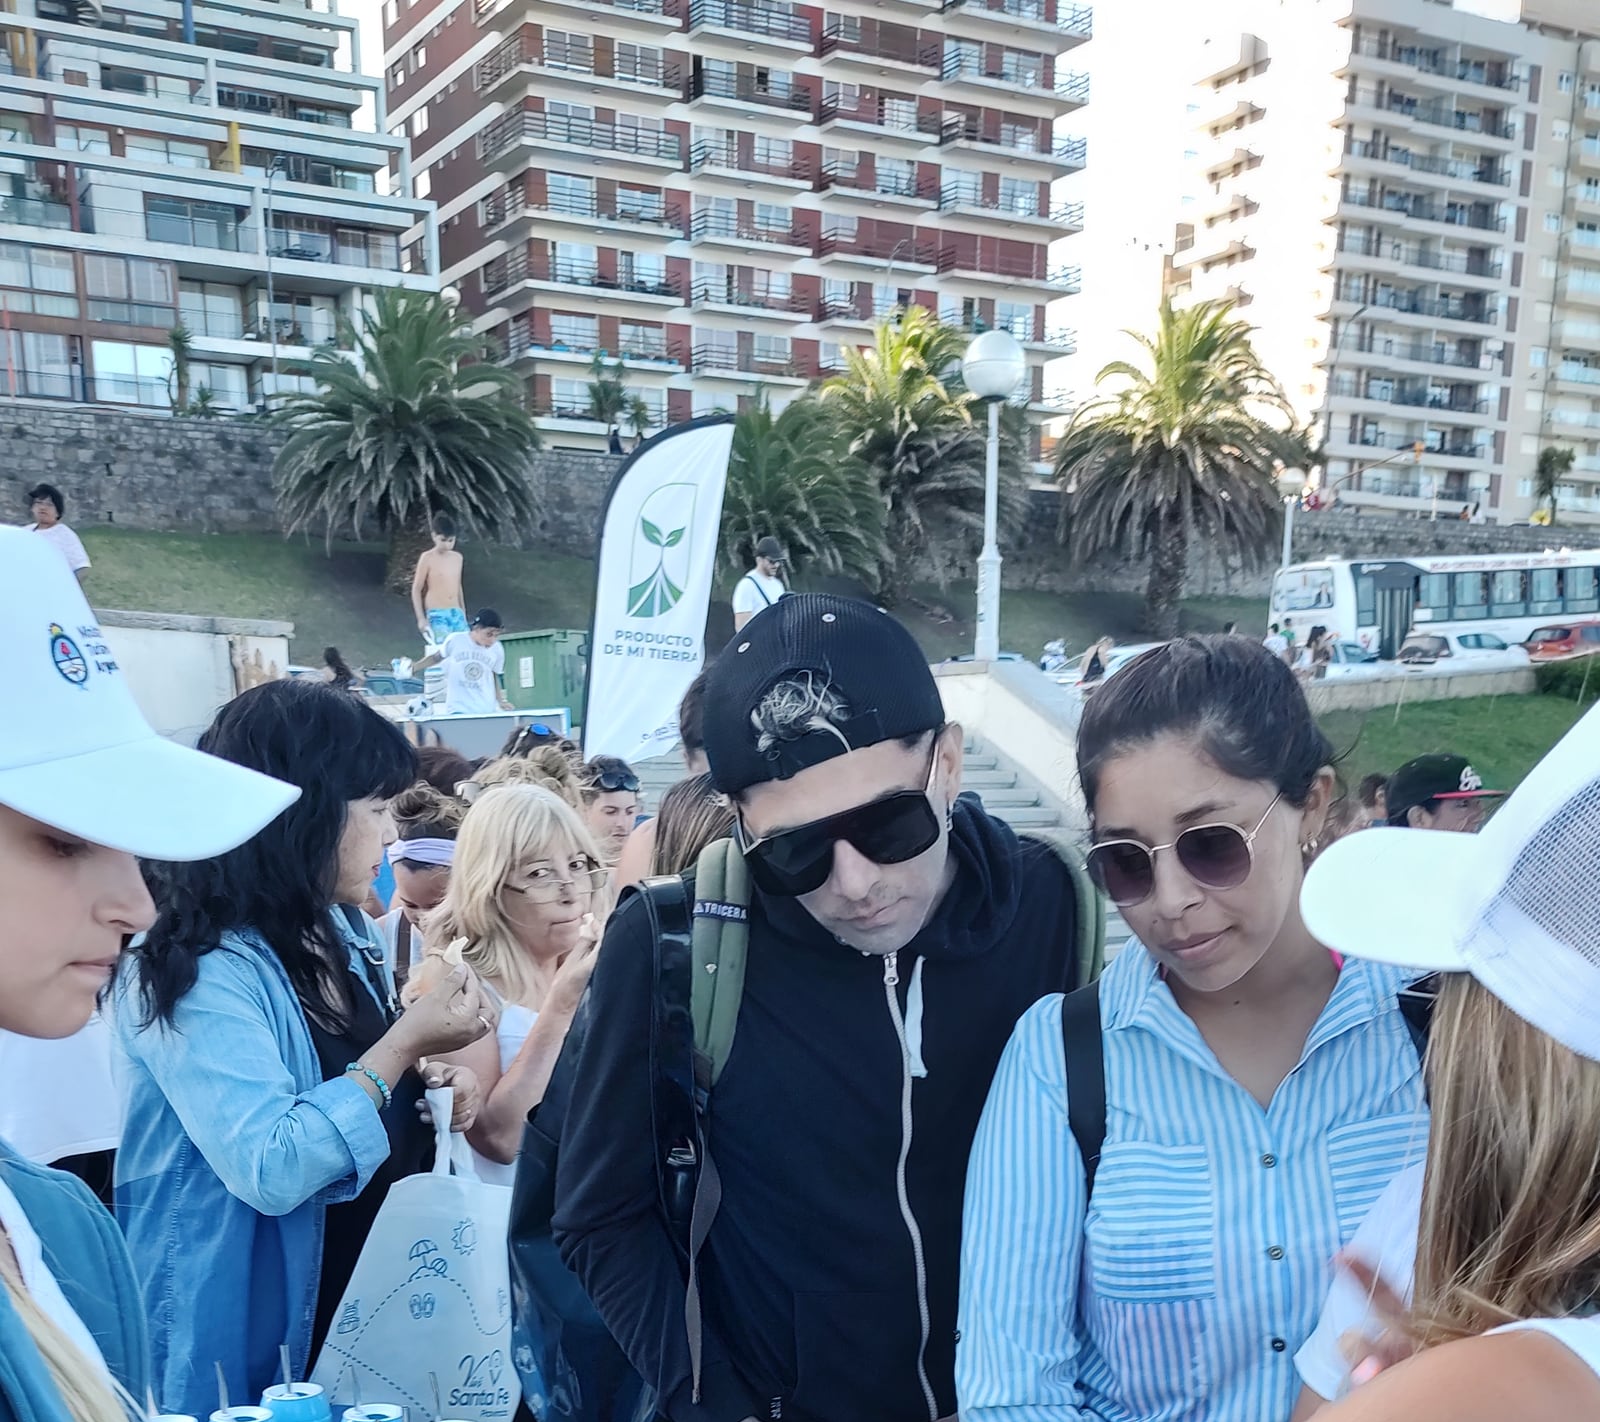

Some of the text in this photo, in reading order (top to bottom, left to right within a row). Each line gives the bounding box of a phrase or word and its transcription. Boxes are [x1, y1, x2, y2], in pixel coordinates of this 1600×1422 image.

[615, 630, 693, 647] PRODUCTO
[604, 643, 624, 656] DE
[627, 646, 644, 657] MI
[448, 1388, 495, 1406] Santa
